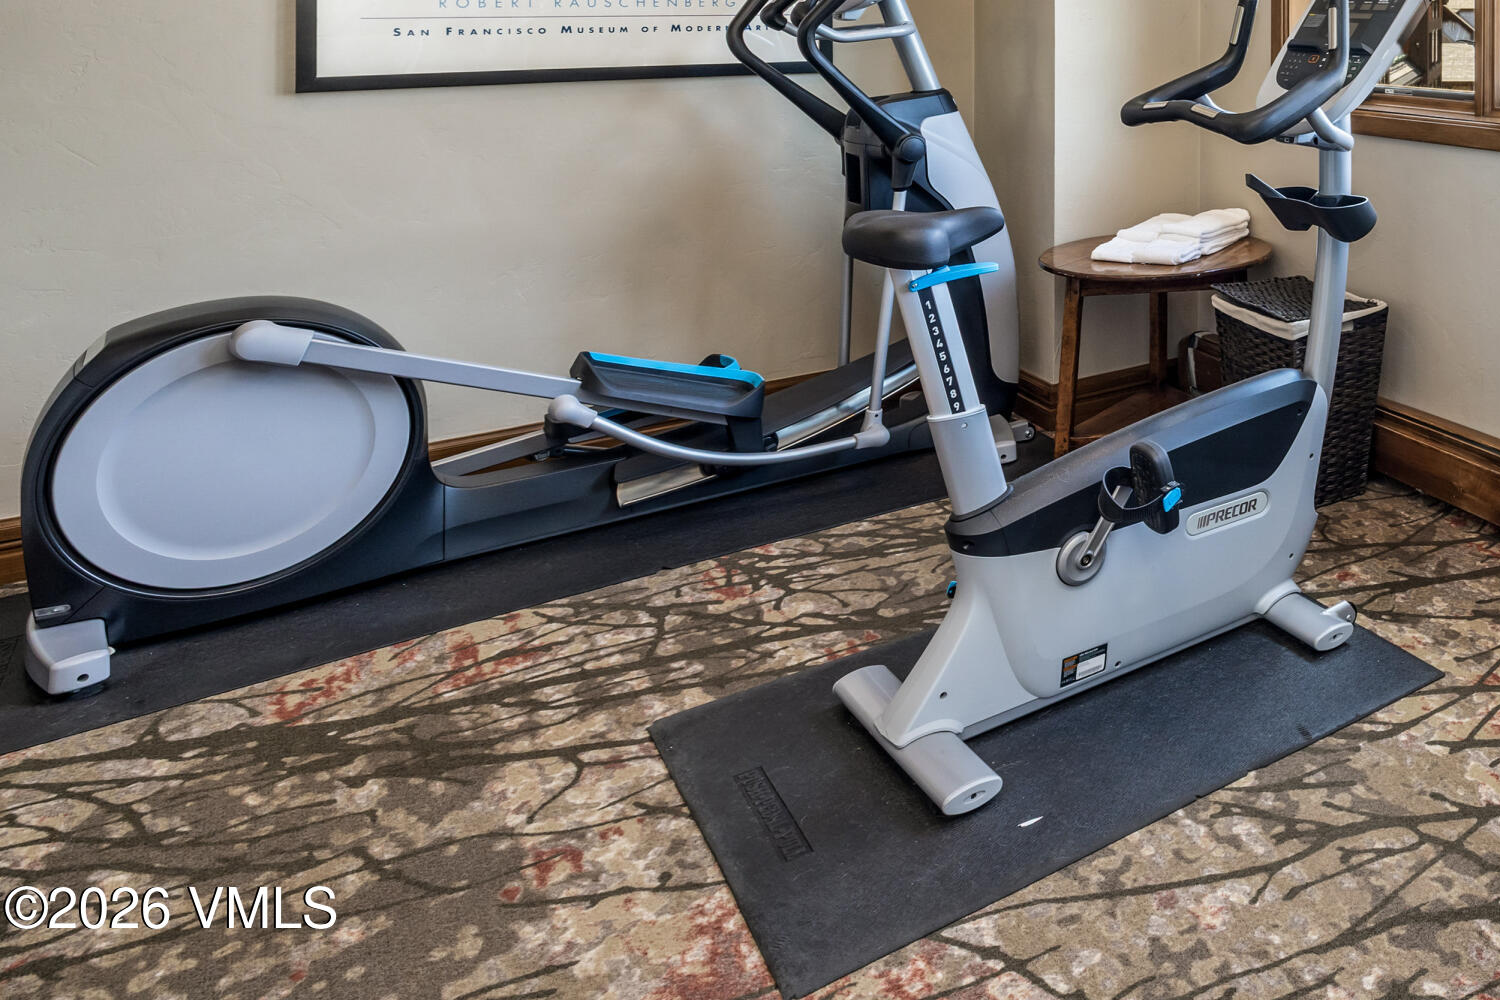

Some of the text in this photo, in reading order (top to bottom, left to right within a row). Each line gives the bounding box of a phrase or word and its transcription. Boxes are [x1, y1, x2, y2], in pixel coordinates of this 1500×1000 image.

[393, 27, 431, 37] SAN
[445, 26, 547, 36] FRANCISCO
[560, 25, 629, 34] MUSEUM
[641, 25, 659, 33] OF
[925, 300, 932, 310] 1
[928, 313, 936, 324] 2
[932, 326, 939, 336] 3
[936, 339, 943, 349] 4
[939, 351, 947, 361] 5
[943, 364, 950, 374] 6
[946, 377, 953, 386] 7
[950, 389, 957, 398] 8
[953, 402, 960, 411] 9
[1205, 498, 1258, 527] PRECOR
